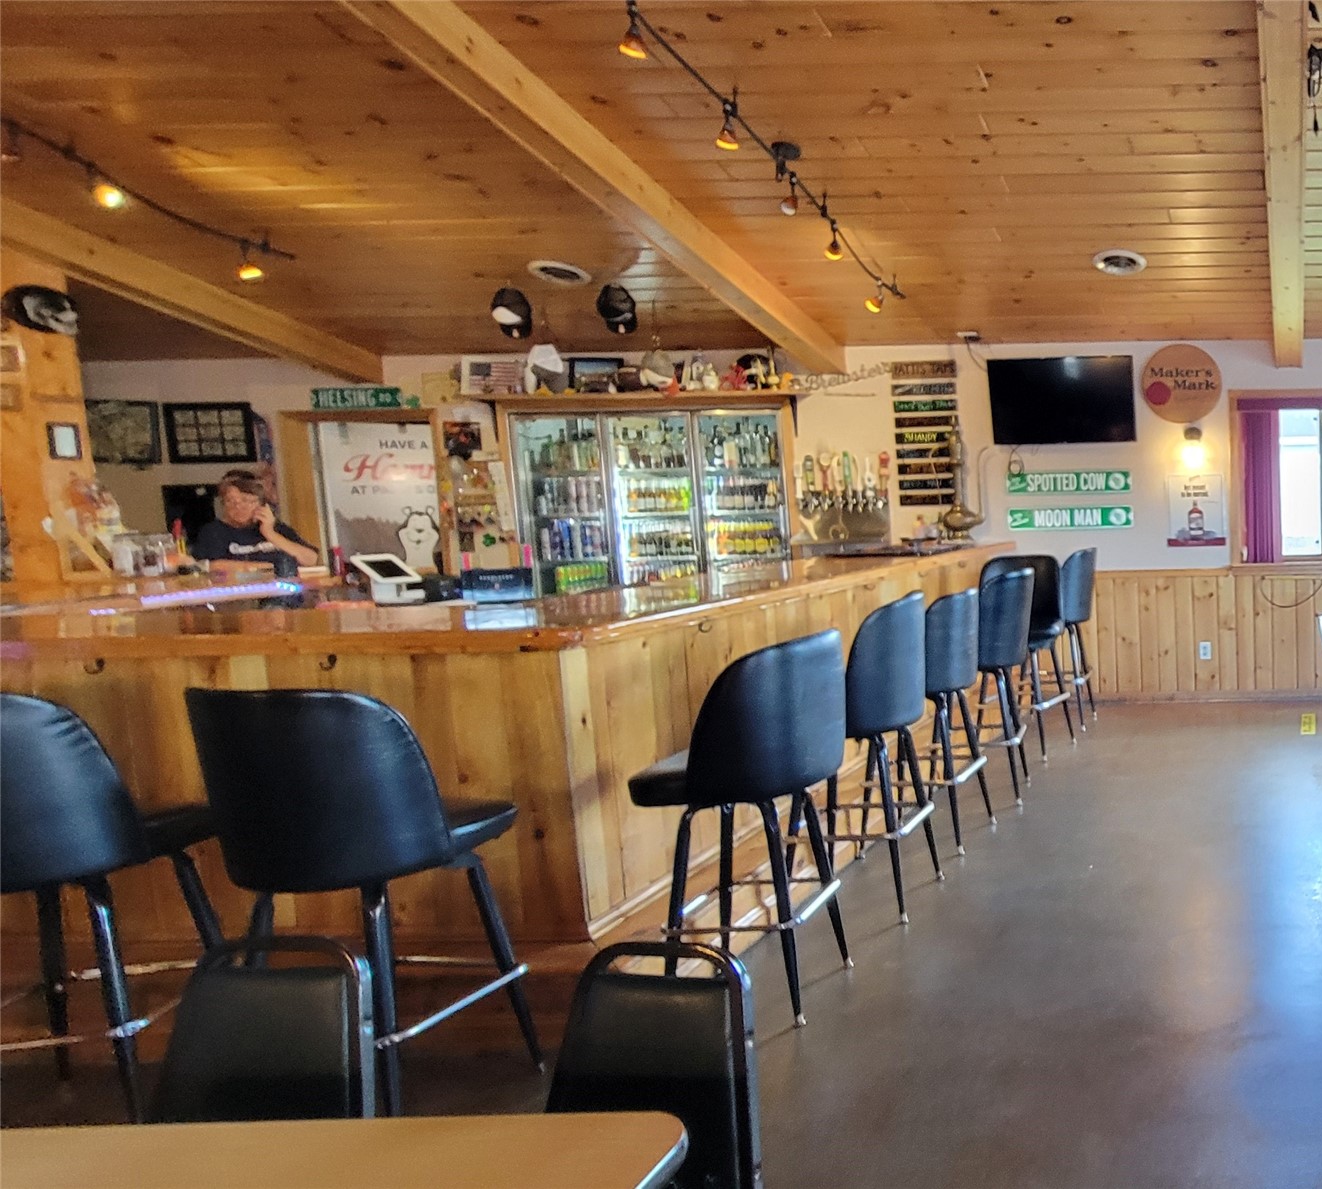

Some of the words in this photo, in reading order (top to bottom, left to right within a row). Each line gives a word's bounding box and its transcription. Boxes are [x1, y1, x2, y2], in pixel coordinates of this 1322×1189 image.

[1150, 367, 1213, 378] Maker's
[1173, 379, 1217, 390] Mark
[318, 388, 376, 408] HELSING
[379, 440, 415, 450] HAVE
[420, 440, 428, 449] A
[1026, 472, 1077, 491] SPOTTED
[1080, 472, 1107, 491] COW
[350, 486, 368, 495] AT
[1034, 509, 1070, 527] MOON
[1073, 508, 1102, 526] MAN
